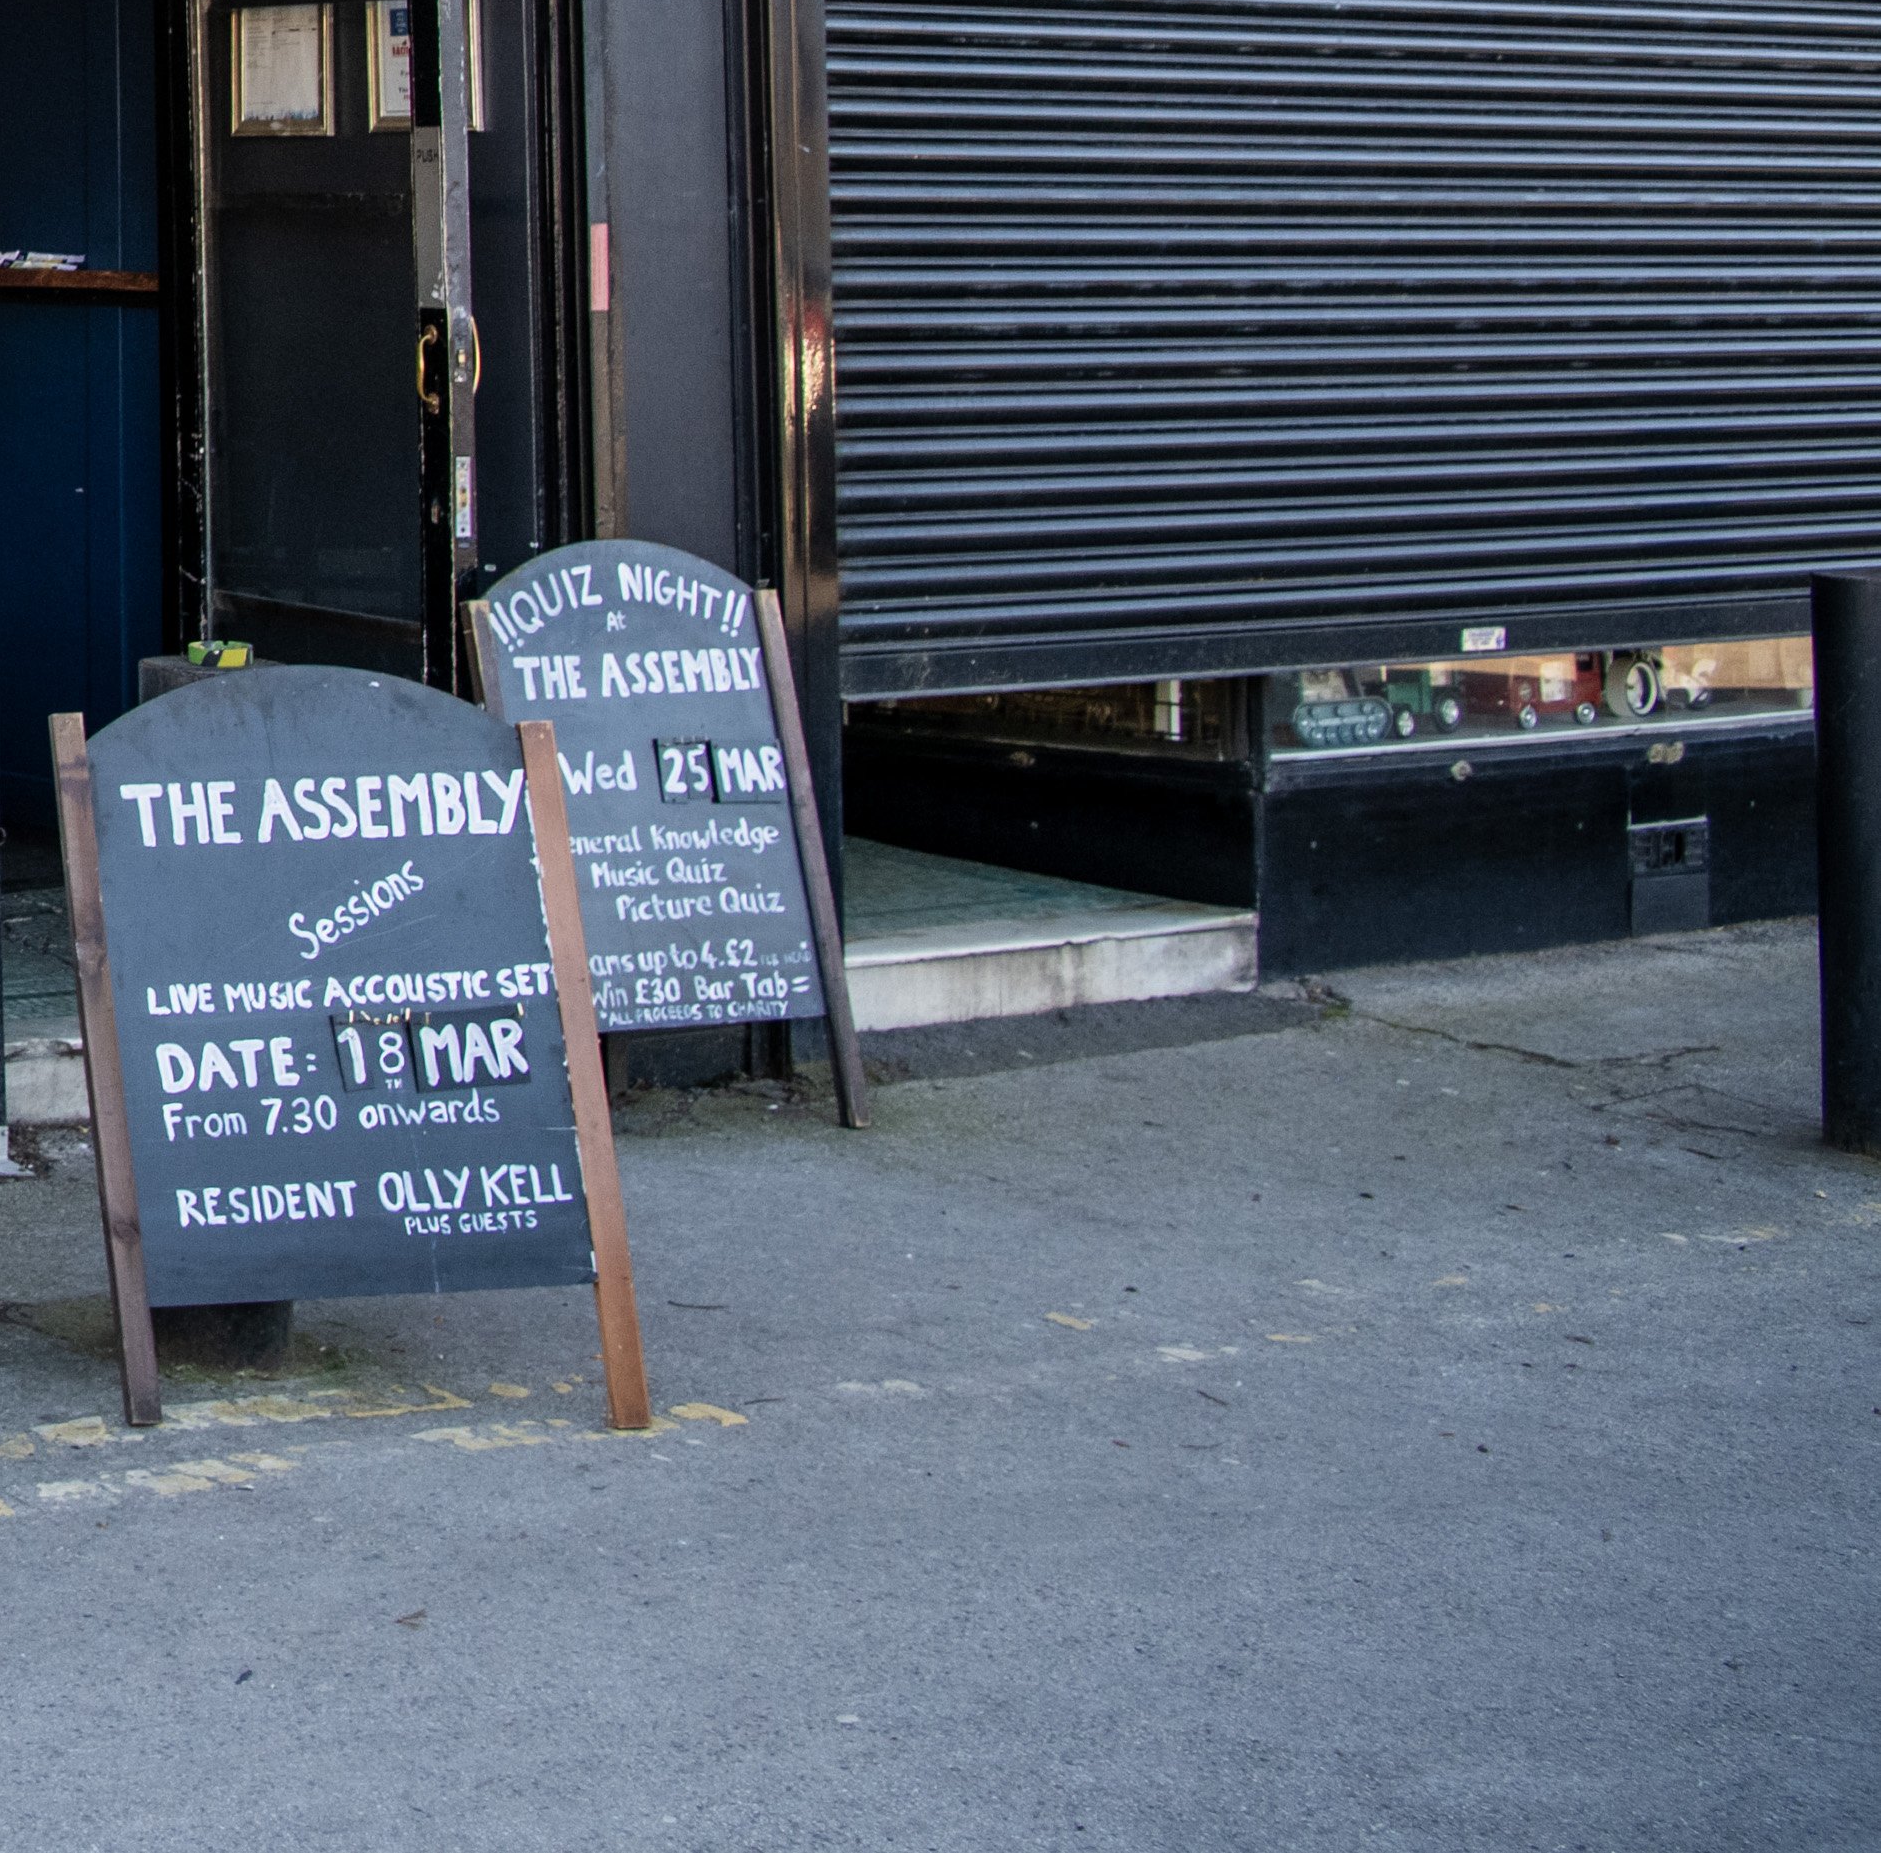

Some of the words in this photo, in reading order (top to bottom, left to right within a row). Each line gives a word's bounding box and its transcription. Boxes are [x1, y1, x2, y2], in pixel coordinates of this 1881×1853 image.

[606, 610, 626, 632] At
[513, 655, 587, 700] THE
[601, 647, 762, 699] ASSEMBLY
[557, 750, 637, 795] Wed
[663, 744, 710, 794] 25
[717, 746, 785, 793] MAR
[120, 780, 242, 847] THE
[258, 769, 524, 843] ASSEMBLY
[569, 826, 641, 855] eneral
[650, 817, 781, 854] Knowledge
[591, 860, 659, 888] Music
[666, 857, 727, 884] Quiz
[288, 859, 425, 959] Sessions
[615, 893, 713, 922] Picture
[719, 884, 785, 914] Quiz
[638, 950, 667, 975] up
[670, 943, 698, 970] to
[146, 982, 215, 1016] LIVE
[225, 980, 313, 1014] MUSIC
[324, 970, 489, 1008] ACCOUSTIC
[496, 963, 552, 997] SET
[592, 981, 628, 1009] Win
[635, 977, 681, 1005] £30
[694, 975, 734, 1001] Bar
[707, 1004, 723, 1019] TO
[727, 1000, 788, 1018] CHARITY
[155, 1037, 319, 1094] DATE:
[418, 1018, 530, 1087] MAR
[162, 1102, 248, 1141] From
[261, 1094, 337, 1135] 7.30
[358, 1090, 500, 1130] onwards
[176, 1180, 356, 1227] RESIDENT
[378, 1166, 469, 1214] OLLY
[481, 1164, 573, 1206] KELL
[404, 1215, 451, 1236] PLUS
[458, 1210, 538, 1235] GUESTS
